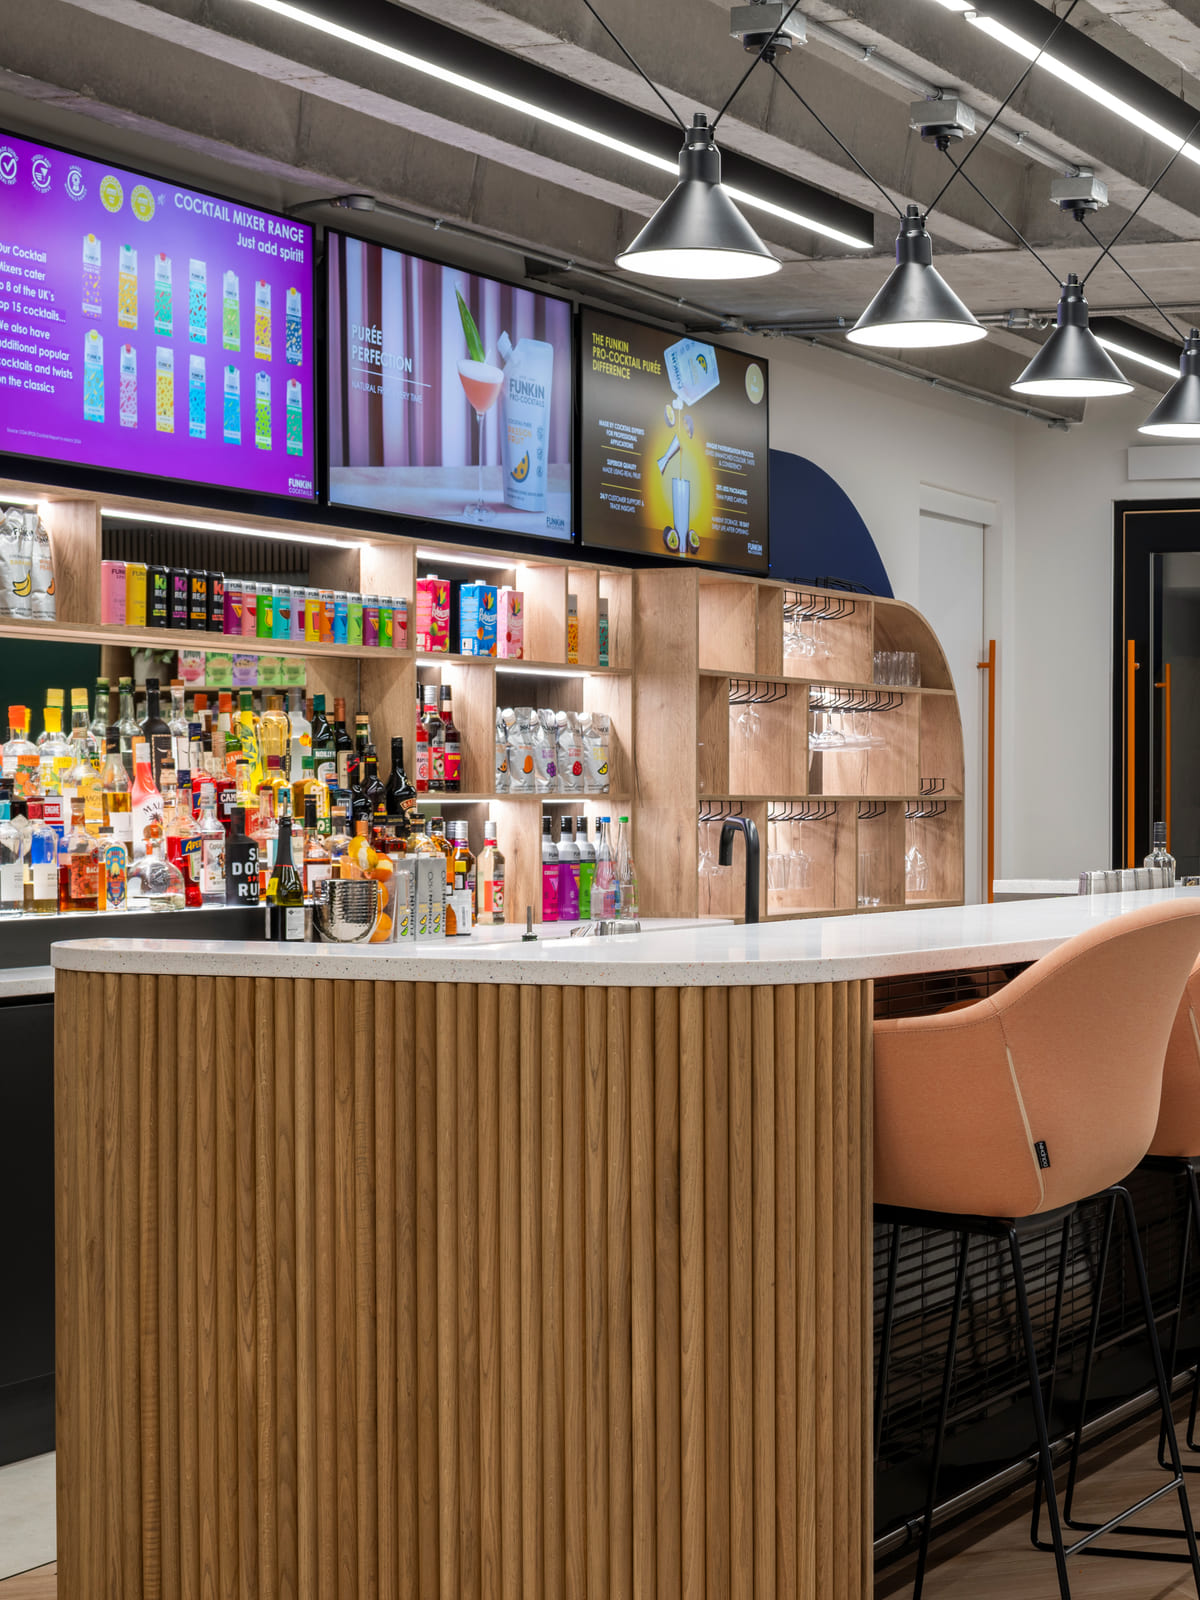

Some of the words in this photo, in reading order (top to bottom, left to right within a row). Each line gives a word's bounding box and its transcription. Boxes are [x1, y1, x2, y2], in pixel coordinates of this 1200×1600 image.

[174, 192, 230, 222] COCKTAIL
[233, 210, 265, 232] MIXER
[268, 220, 304, 244] RANGE
[12, 246, 47, 263] Cocktail
[236, 233, 256, 249] Just
[258, 241, 278, 256] add
[280, 248, 304, 263] spirit!
[24, 268, 46, 281] cater
[6, 281, 11, 292] 8
[13, 284, 21, 294] of
[23, 286, 36, 297] the
[38, 288, 55, 302] UK's
[12, 301, 21, 313] 15
[11, 322, 28, 335] also
[30, 326, 50, 340] have
[352, 324, 382, 346] PURÉE
[592, 332, 604, 346] THE
[606, 336, 629, 353] FUNKIN
[39, 347, 70, 361] popular
[352, 344, 412, 373] PERFECTION
[592, 346, 641, 370] PRO-COCKTAIL
[642, 360, 661, 375] PURÉE
[35, 364, 51, 375] and
[52, 366, 73, 379] twists
[592, 359, 630, 380] DIFFERENCE
[8, 375, 22, 388] the
[24, 379, 55, 394] classics
[510, 378, 545, 400] FUNKIN
[288, 478, 312, 490] FUNKIN
[546, 516, 565, 527] FUNKIN
[238, 883, 259, 896] RU
